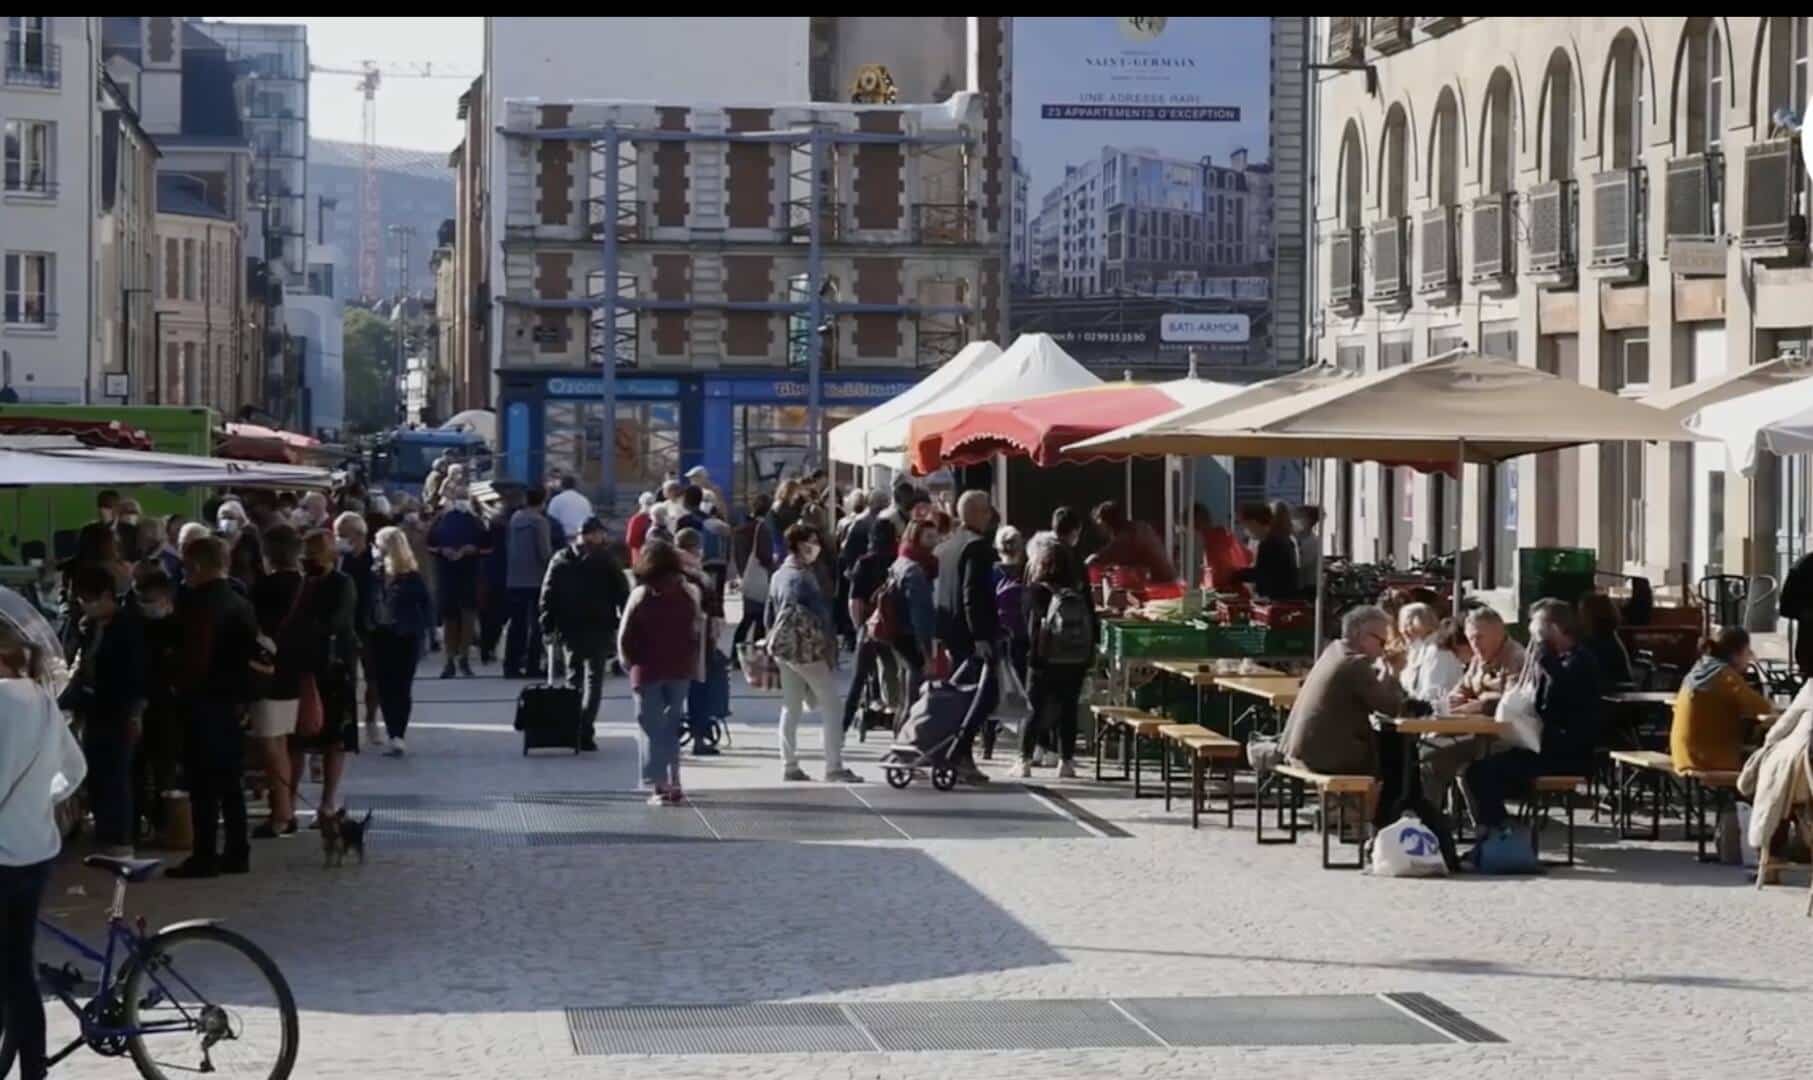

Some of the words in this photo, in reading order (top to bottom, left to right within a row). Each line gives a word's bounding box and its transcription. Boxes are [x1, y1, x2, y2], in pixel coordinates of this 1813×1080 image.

[1085, 57, 1196, 67] SAINT-GERMAIN
[1080, 93, 1102, 103] UNE
[1110, 93, 1165, 104] ADRESSE
[1064, 107, 1154, 118] APPARTEMENTS
[1157, 109, 1235, 119] D'EXCEPTION
